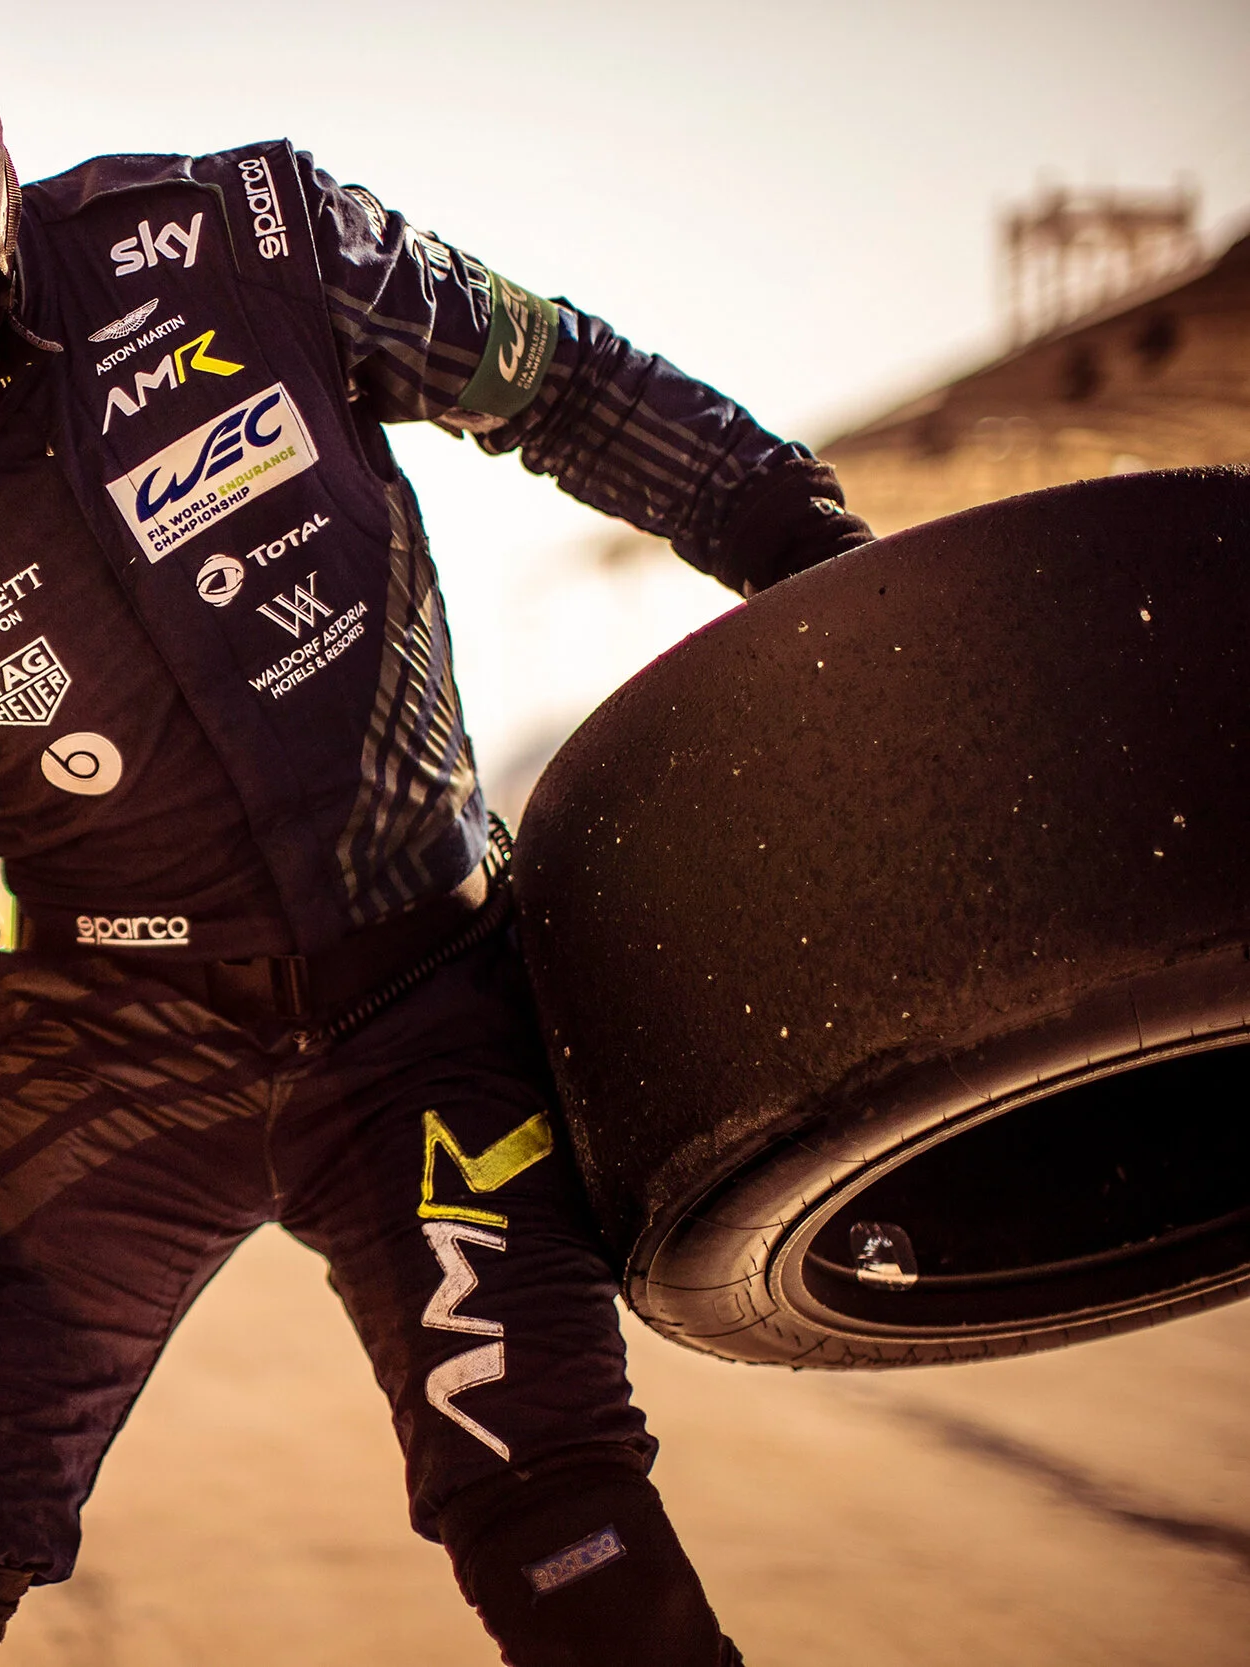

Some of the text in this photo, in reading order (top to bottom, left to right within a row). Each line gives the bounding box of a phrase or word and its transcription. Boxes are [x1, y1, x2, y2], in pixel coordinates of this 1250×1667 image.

[238, 156, 289, 260] sparco
[110, 213, 203, 277] sky
[95, 315, 186, 376] ASTON MARTIN
[525, 335, 539, 370] WORLD
[102, 330, 245, 435] AMR
[135, 391, 281, 523] WEC
[147, 445, 296, 542] FIA WORLD ENDURANCE
[154, 486, 250, 552] CHAMPIONSHIP
[246, 513, 330, 567] TOTAL
[248, 601, 368, 691] WALDORF ASTORIA
[271, 622, 365, 699] HOTELS & RESORTS
[76, 915, 189, 945] sparco
[417, 1110, 553, 1463] AMR
[532, 1533, 621, 1592] sparco
